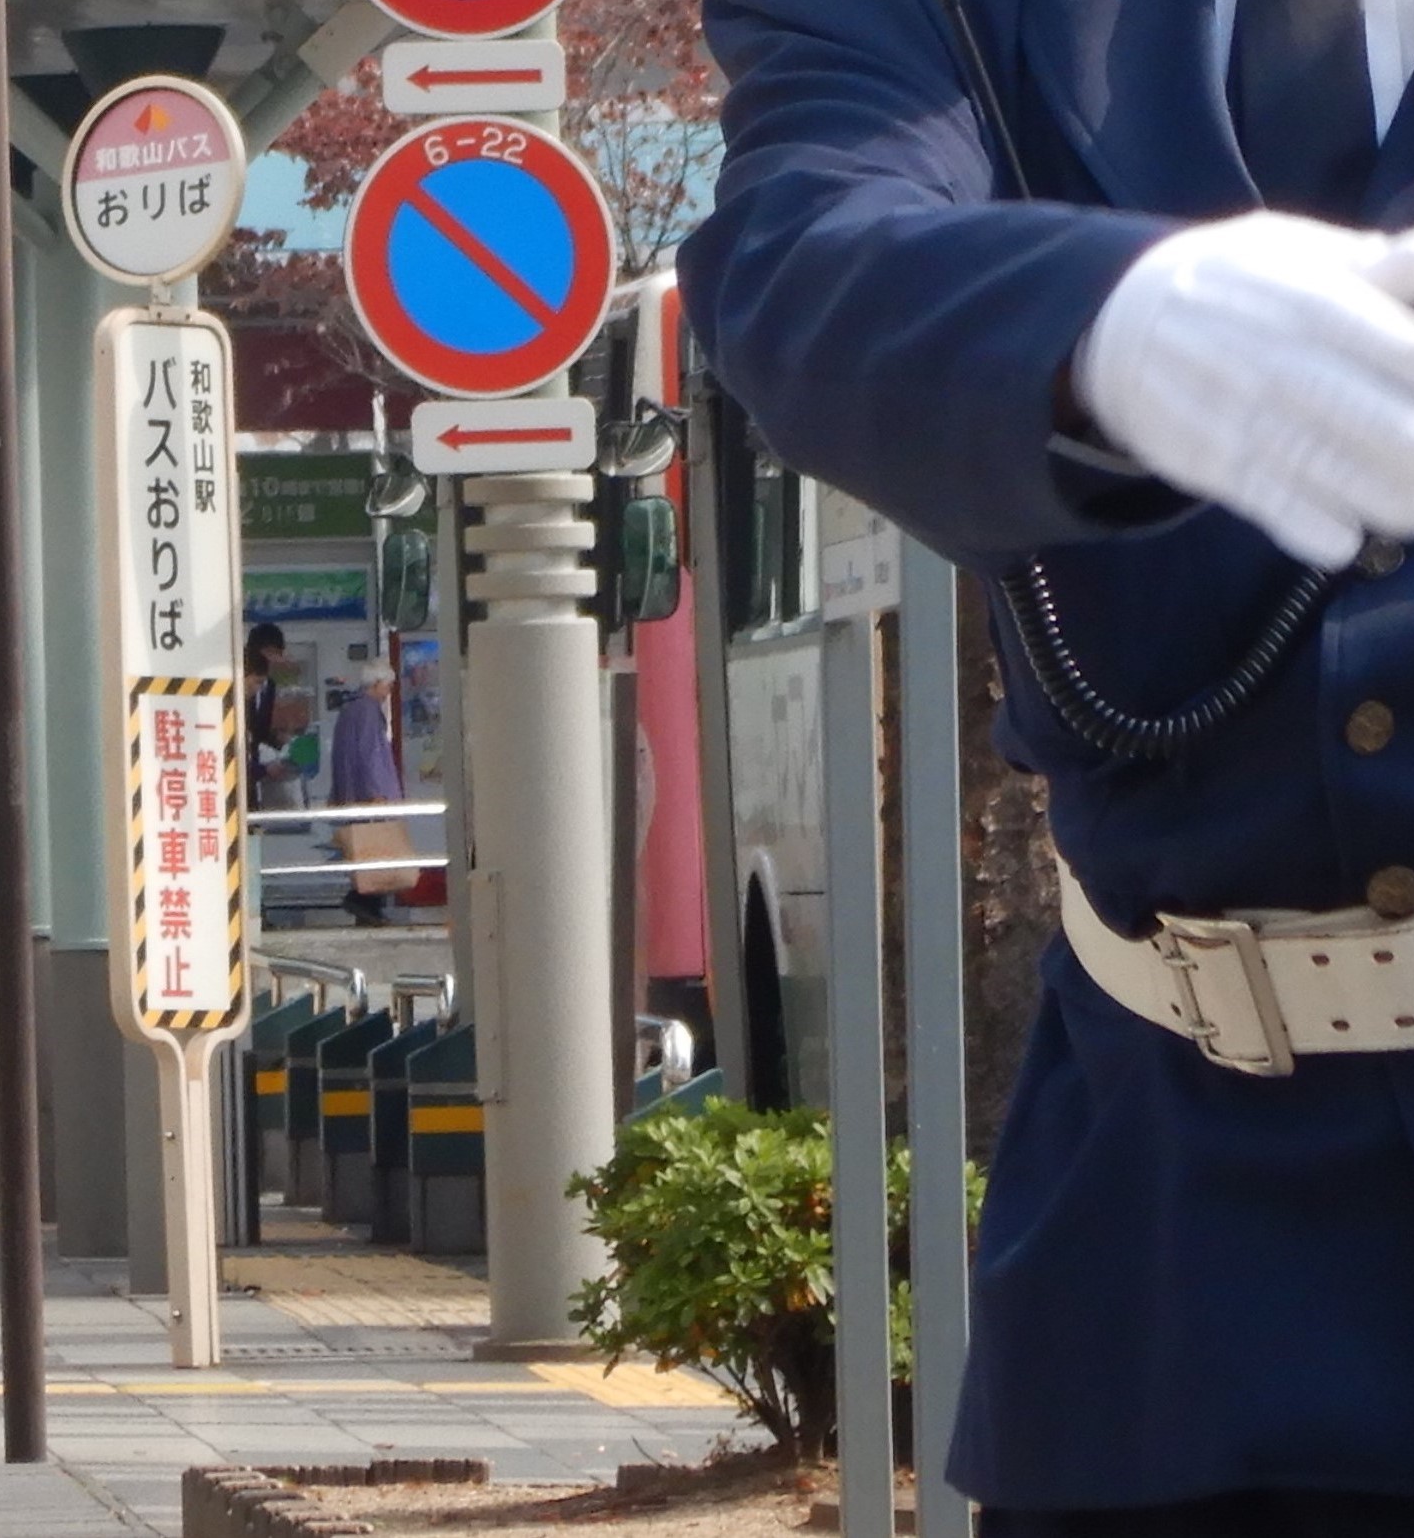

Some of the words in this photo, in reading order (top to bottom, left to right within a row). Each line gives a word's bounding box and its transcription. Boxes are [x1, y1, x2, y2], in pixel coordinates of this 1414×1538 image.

[96, 133, 212, 173] 和歌山バス
[97, 173, 212, 228] おりば
[142, 358, 185, 652] バスおりば
[190, 359, 218, 514] 和歌山駅
[153, 709, 195, 1000] 駐停車禁止
[194, 719, 220, 864] 一般車両
